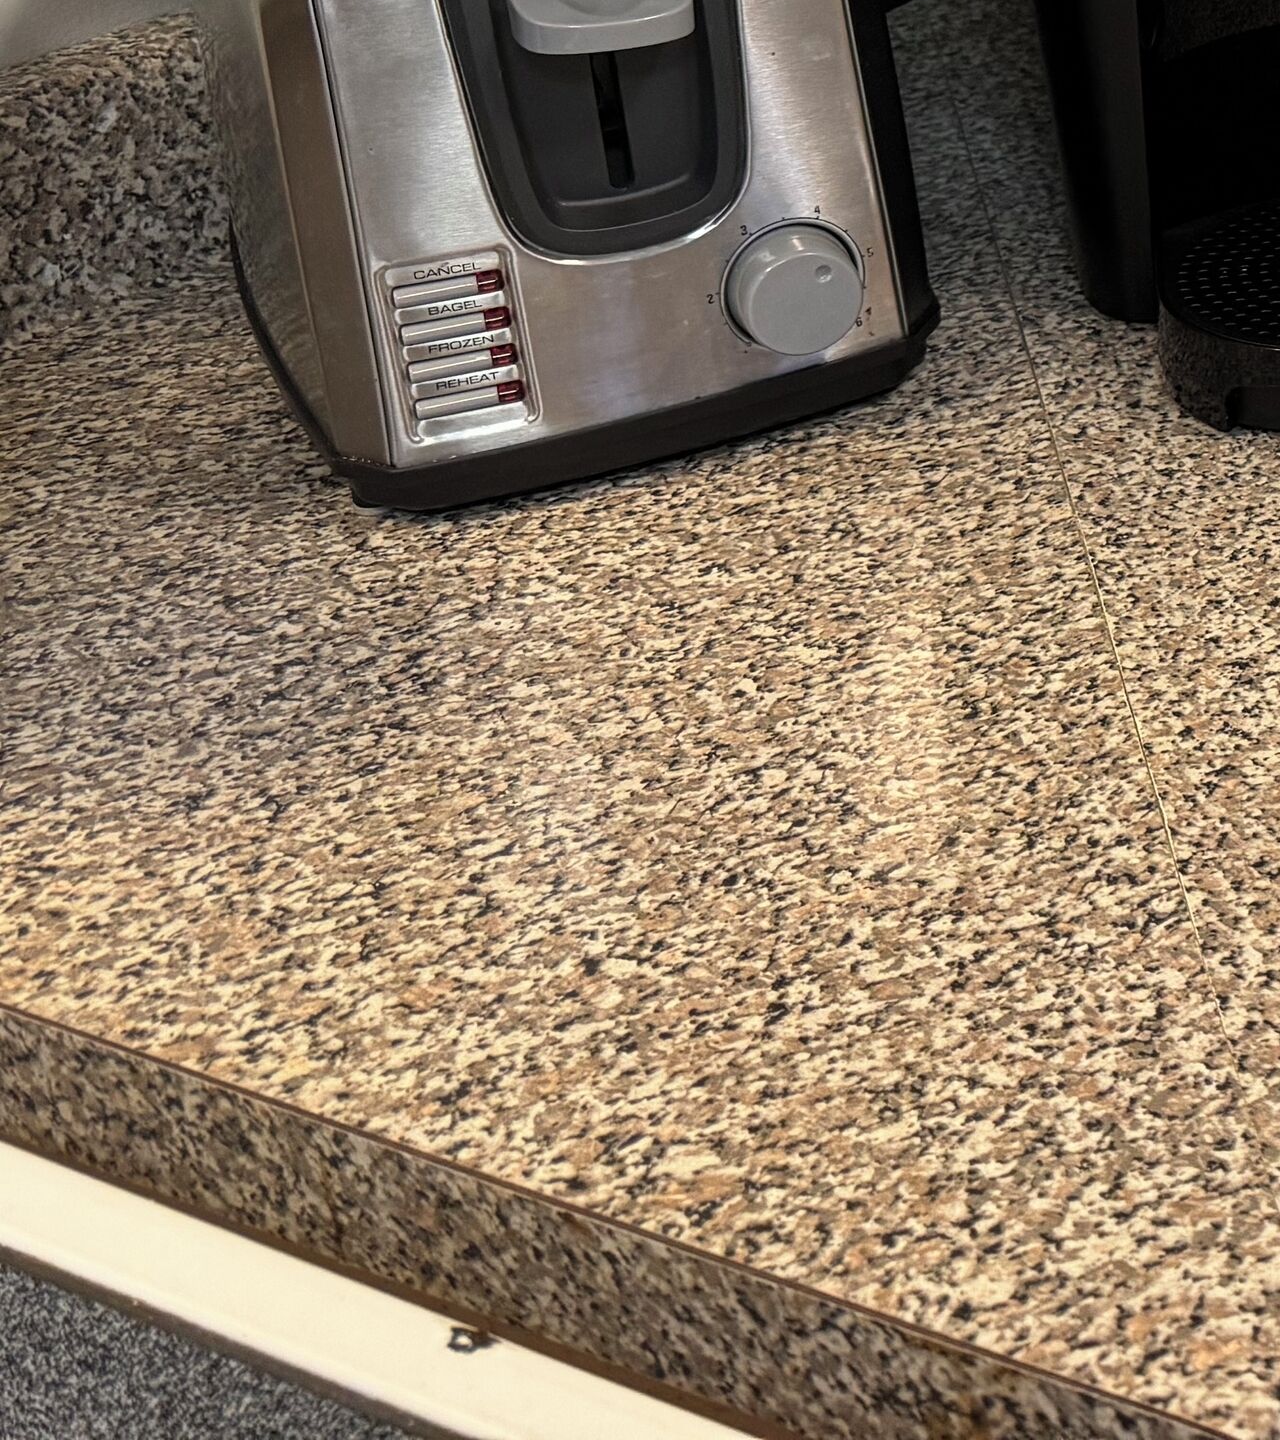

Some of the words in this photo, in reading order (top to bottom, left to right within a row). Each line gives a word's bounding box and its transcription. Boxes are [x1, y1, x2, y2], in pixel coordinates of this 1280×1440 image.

[414, 262, 482, 280] CANCEL
[428, 300, 482, 316] BAGEL
[428, 334, 494, 354] FROZEN
[436, 371, 499, 390] REHEAT
